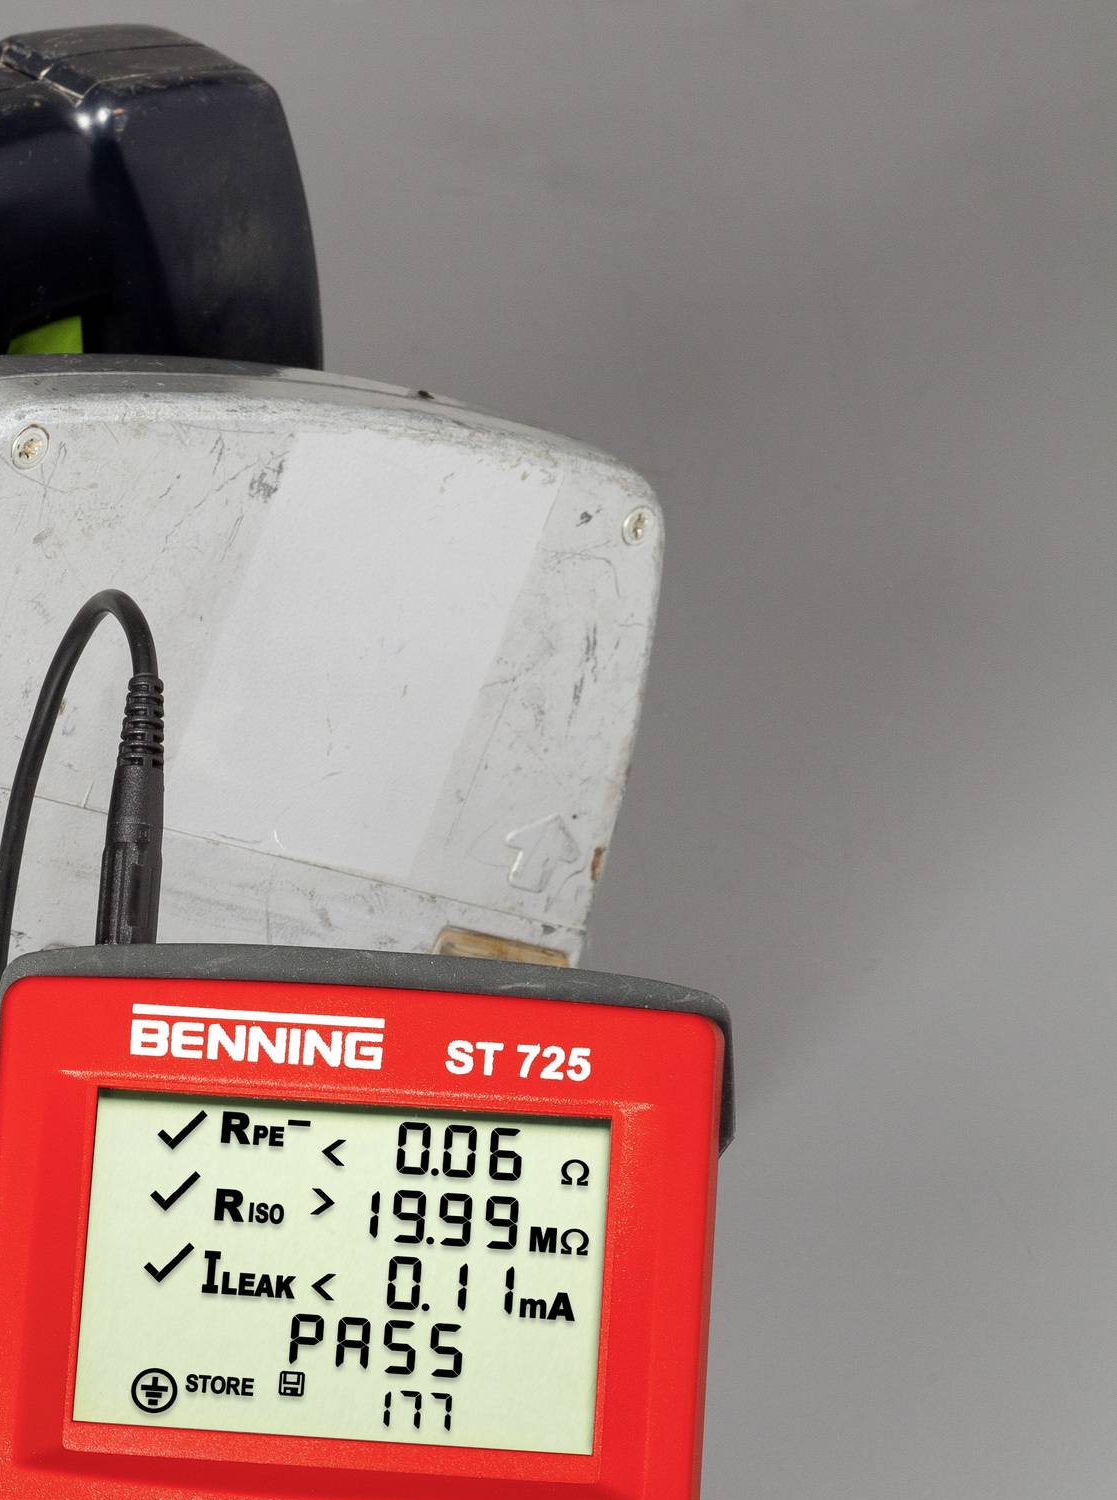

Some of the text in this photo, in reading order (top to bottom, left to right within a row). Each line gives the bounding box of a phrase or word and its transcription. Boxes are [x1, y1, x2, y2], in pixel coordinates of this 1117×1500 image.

[129, 1018, 385, 1071] BENNING
[445, 1039, 591, 1082] ST 725
[395, 1121, 523, 1182] 0.06
[369, 1189, 520, 1251] 19.99
[386, 1255, 515, 1315] 0.11
[519, 1292, 576, 1322] mA
[287, 1313, 464, 1379] PASS
[185, 1373, 255, 1397] STORE
[382, 1390, 453, 1432] 177
